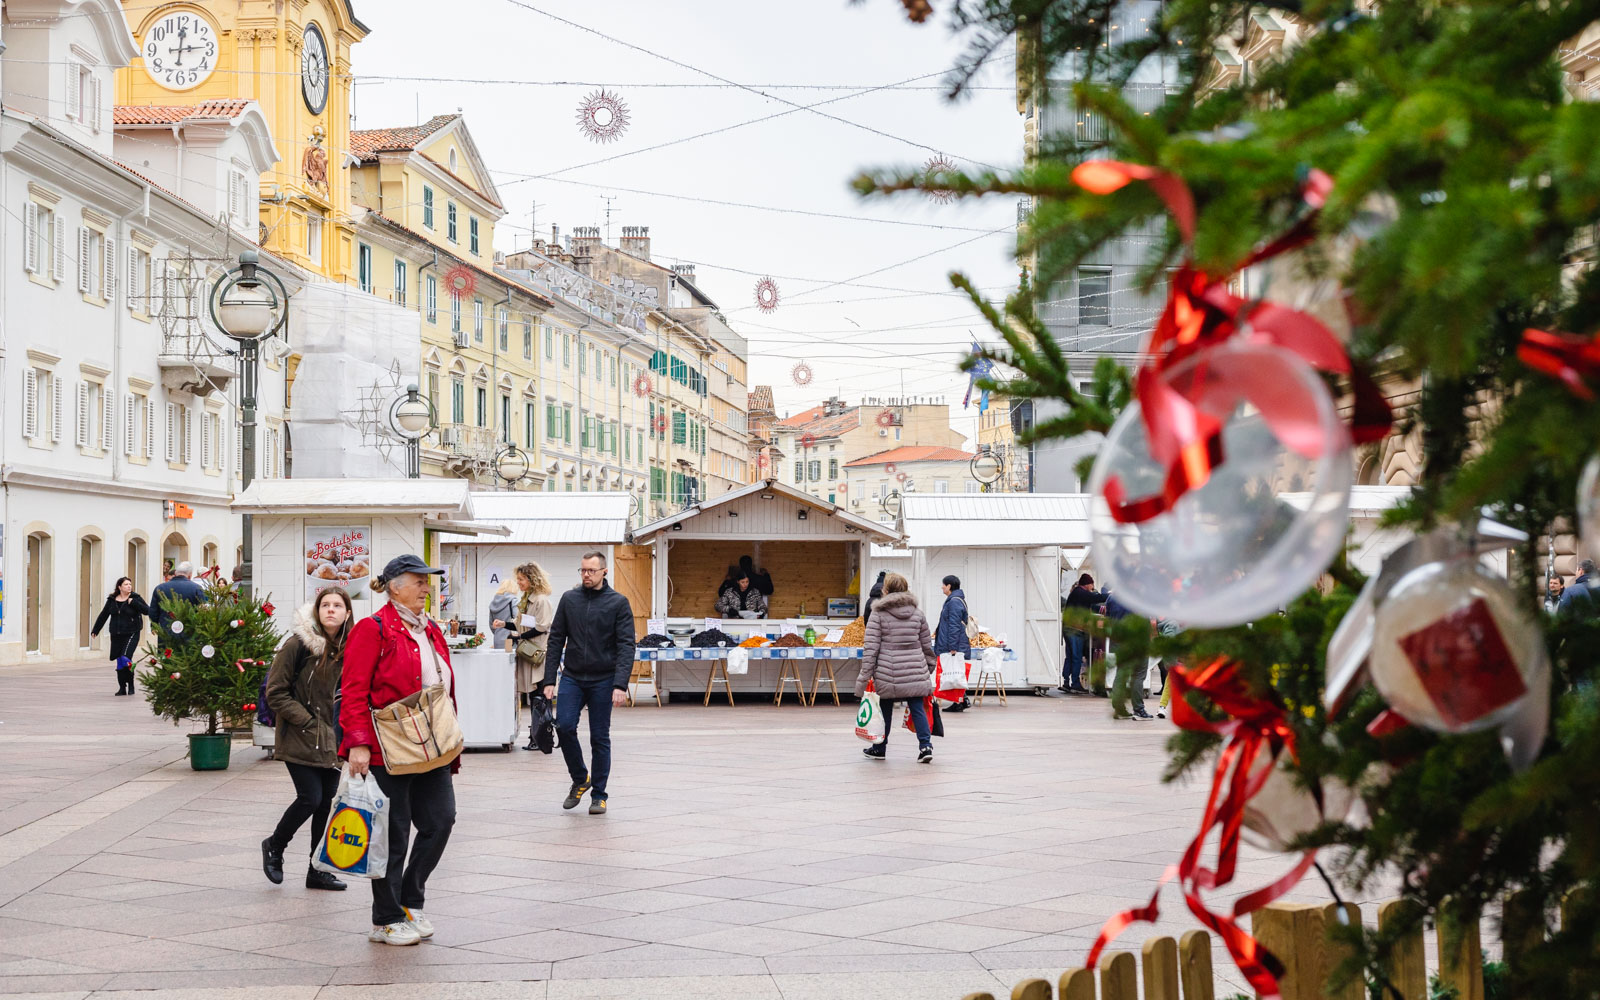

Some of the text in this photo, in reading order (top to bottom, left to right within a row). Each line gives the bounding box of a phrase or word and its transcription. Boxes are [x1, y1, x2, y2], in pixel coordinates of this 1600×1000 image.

[165, 18, 173, 33] 11
[177, 16, 189, 30] 12
[193, 19, 199, 34] 1
[153, 26, 165, 41] 10
[200, 27, 208, 41] 2
[147, 42, 157, 57] 9
[205, 41, 214, 57] 3
[153, 57, 163, 73] 8
[198, 56, 208, 70] 4
[165, 68, 174, 83] 7
[175, 70, 185, 85] 6
[188, 67, 198, 82] 5
[312, 530, 363, 560] Bodulske
[340, 546, 364, 564] frite
[490, 573, 499, 584] A
